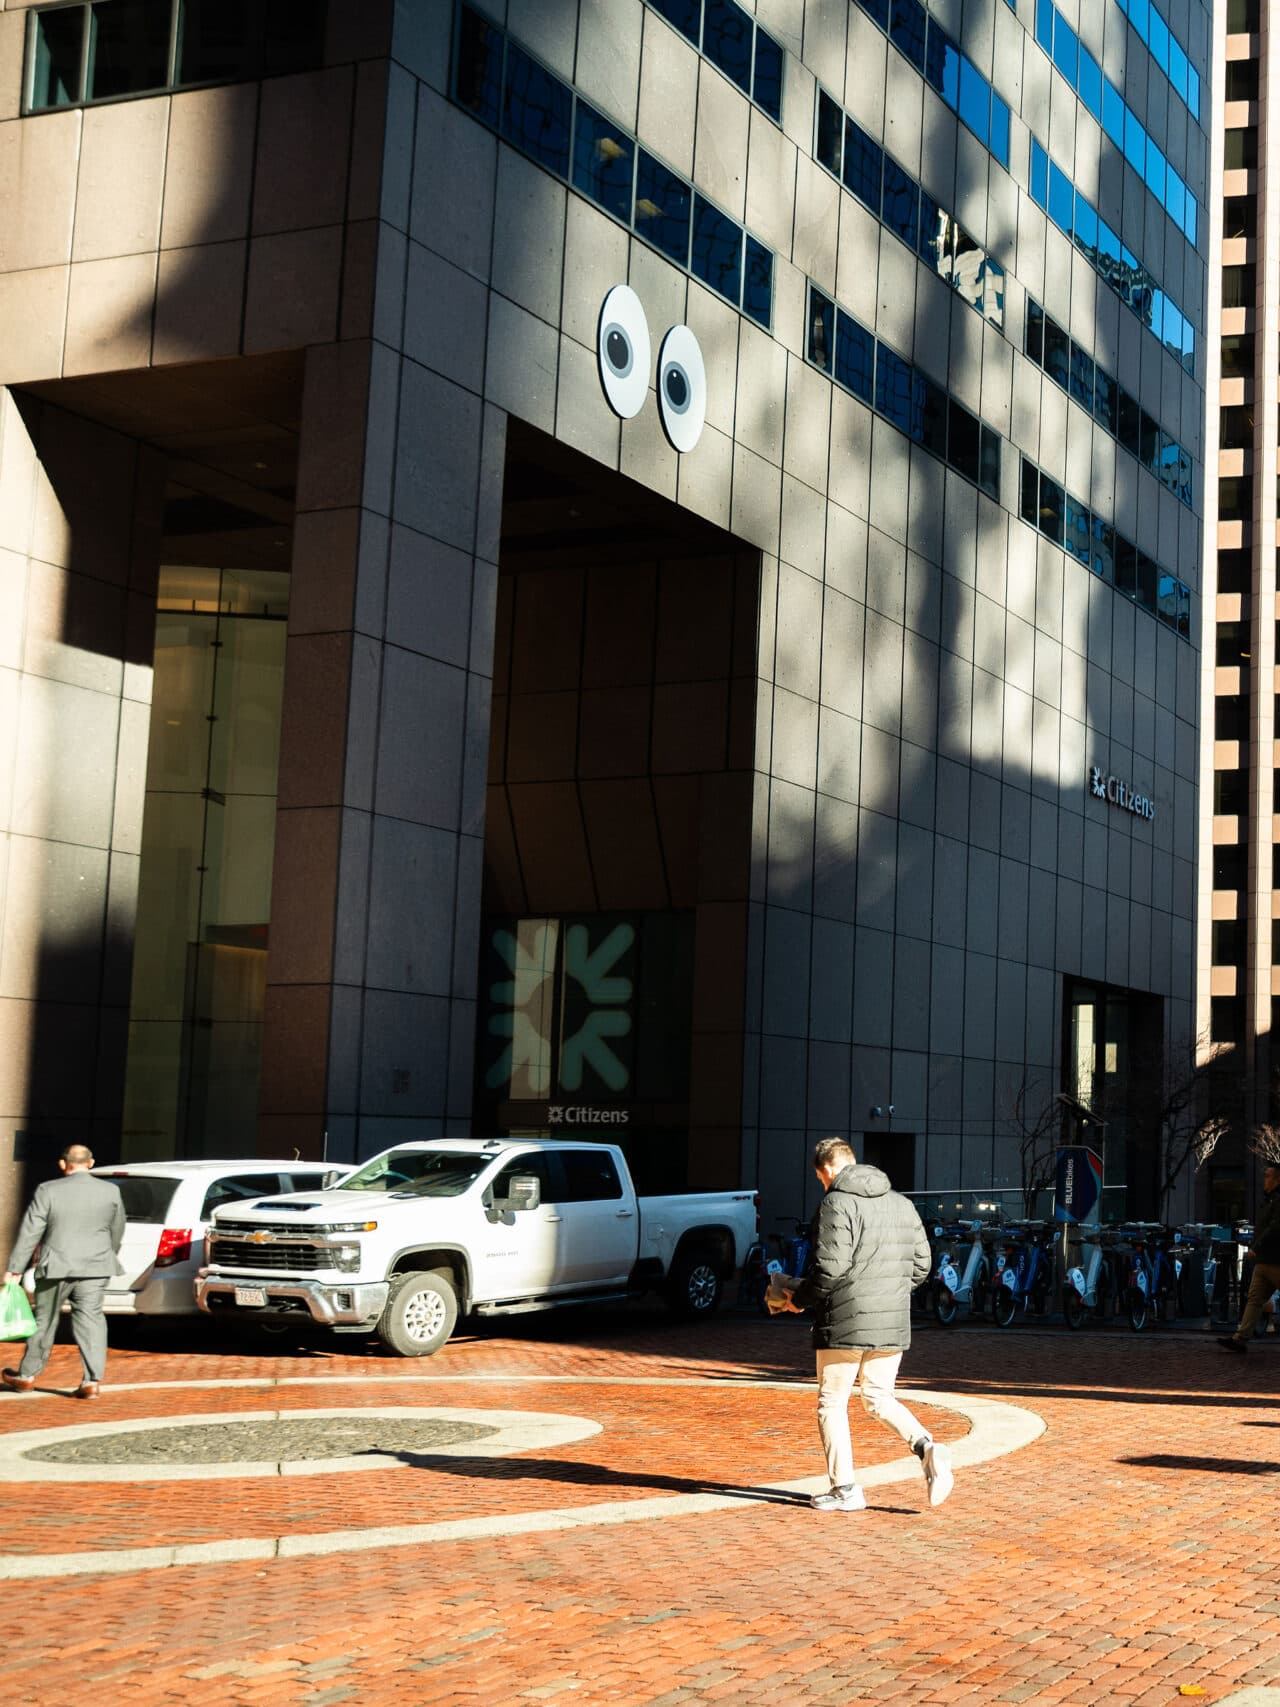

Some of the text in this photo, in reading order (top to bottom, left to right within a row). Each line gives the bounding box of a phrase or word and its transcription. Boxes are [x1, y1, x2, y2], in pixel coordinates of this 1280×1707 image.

[1107, 775, 1155, 821] Citizens
[565, 1107, 629, 1123] Citizens
[1065, 1158, 1074, 1204] BLUEbikes
